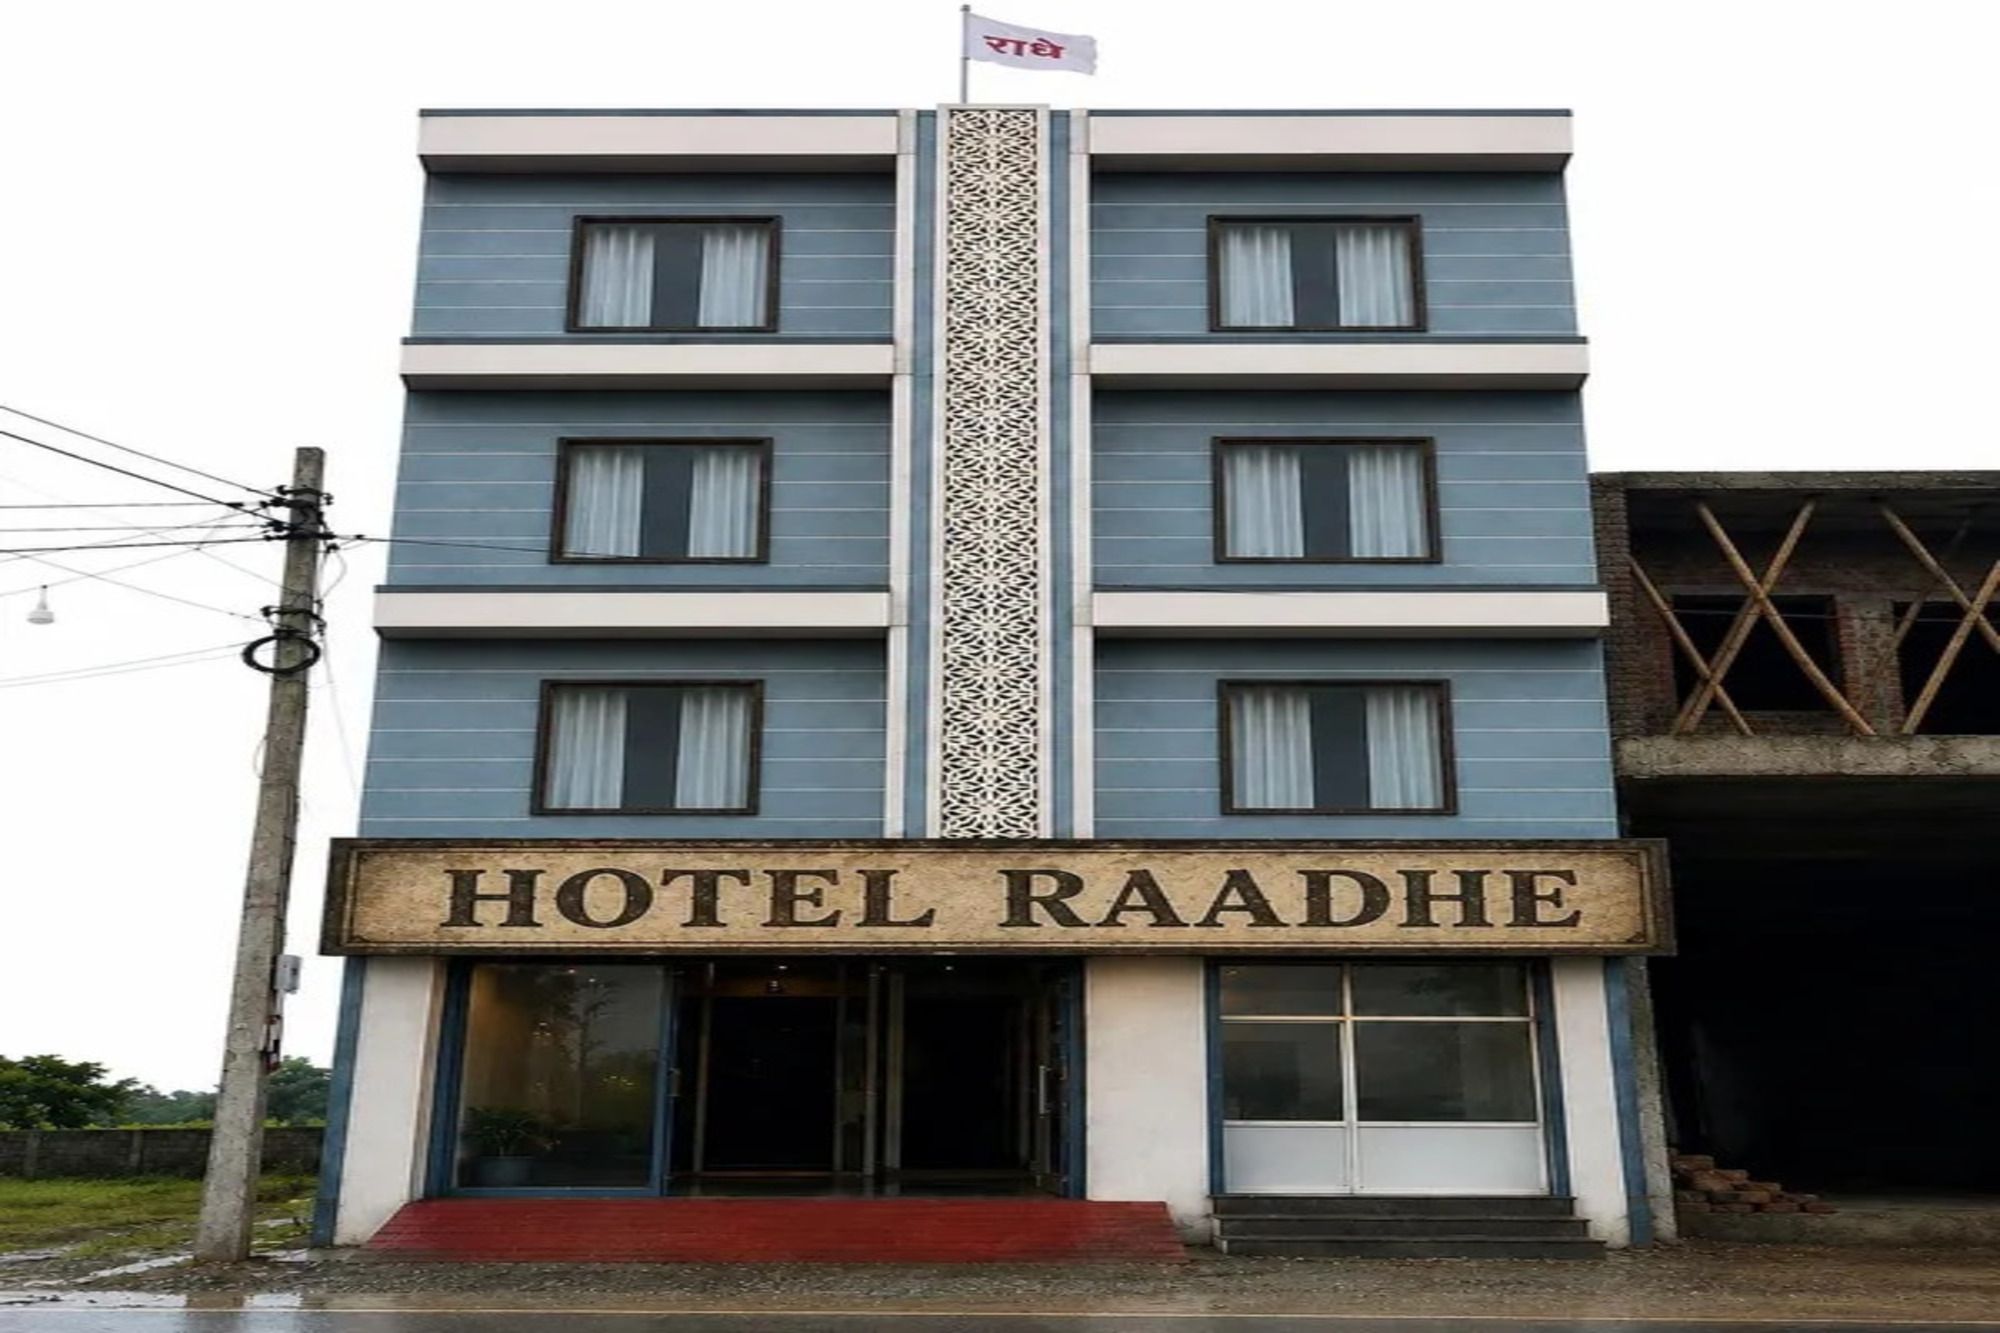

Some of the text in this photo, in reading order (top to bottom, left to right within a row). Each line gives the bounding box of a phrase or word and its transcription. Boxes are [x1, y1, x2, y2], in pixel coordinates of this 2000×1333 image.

[984, 35, 1065, 59] राधे
[440, 867, 1582, 928] HOTEL RAADHE
